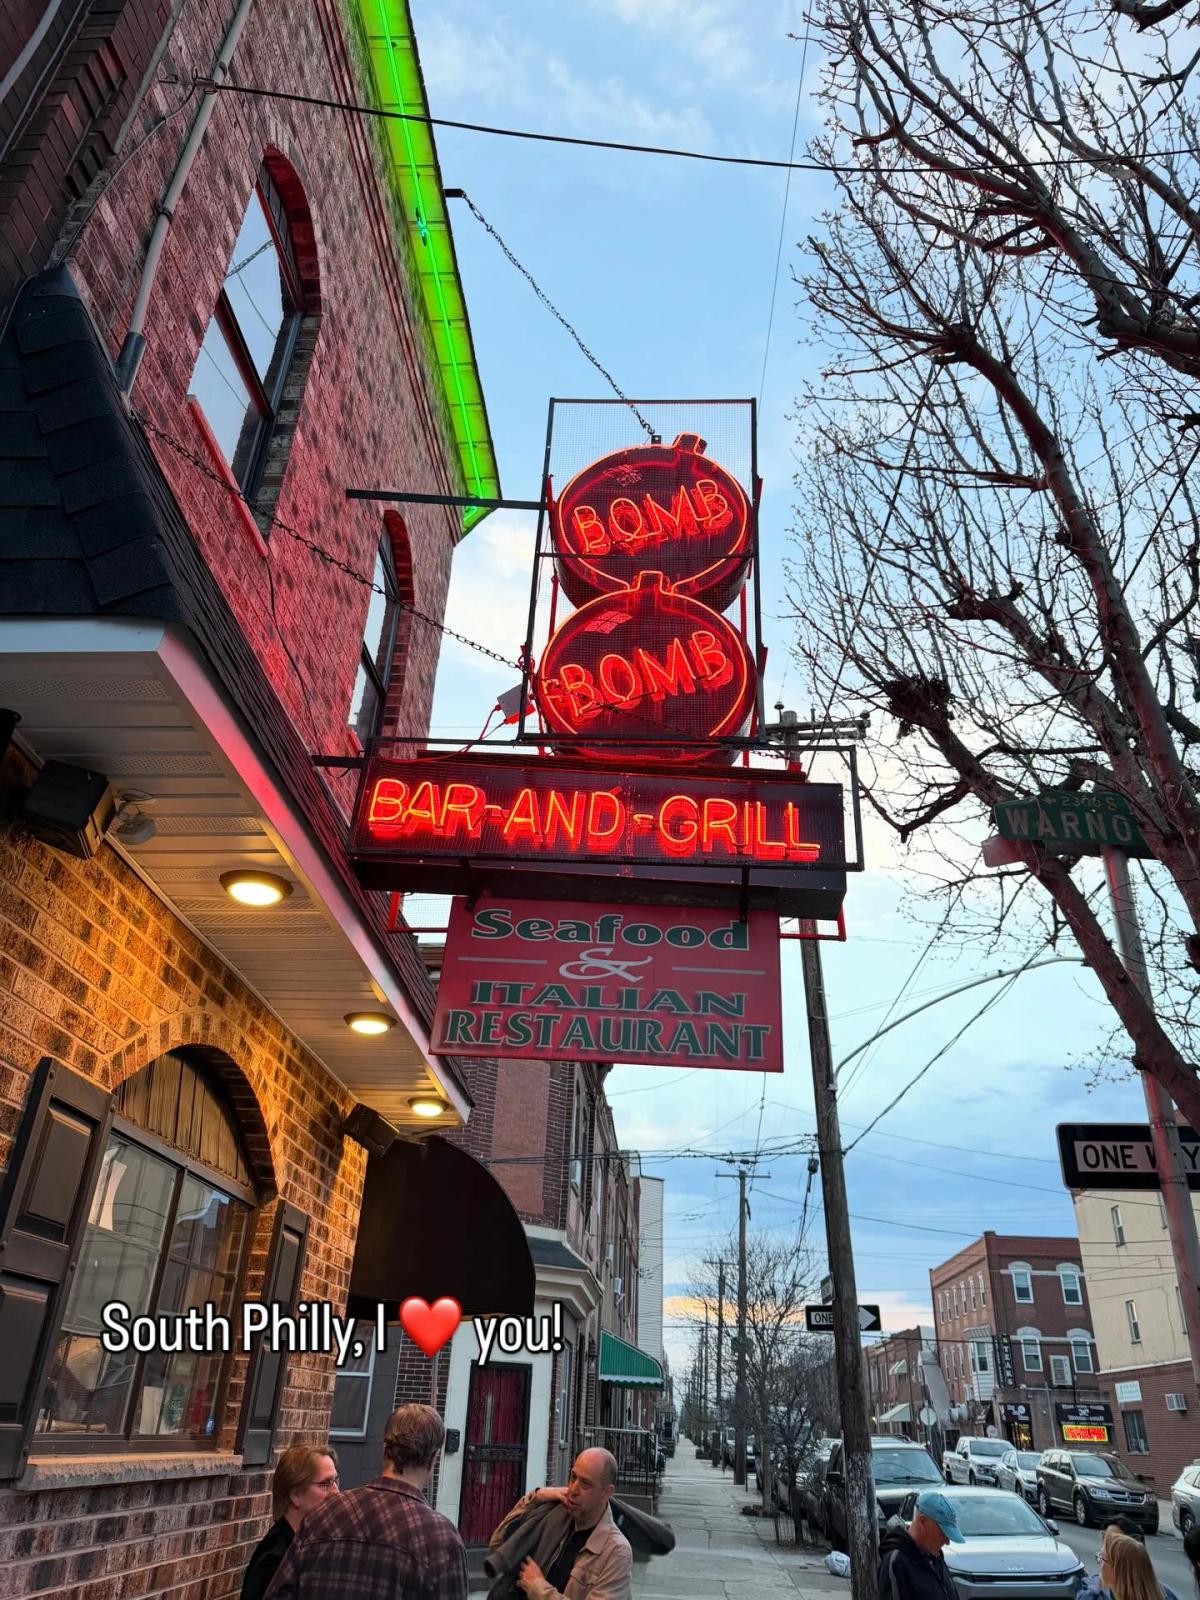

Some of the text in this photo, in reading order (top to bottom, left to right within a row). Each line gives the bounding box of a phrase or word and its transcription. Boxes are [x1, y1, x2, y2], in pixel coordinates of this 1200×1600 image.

[572, 479, 733, 554] BOMB
[560, 630, 734, 720] BOMB
[1004, 807, 1132, 842] WARNO
[471, 908, 750, 951] Seafood
[559, 947, 653, 983] &
[471, 980, 748, 1018] ITALIAN
[443, 1009, 772, 1059] RESTAURANT
[1082, 1144, 1138, 1169] ONE
[814, 1312, 834, 1324] ONE
